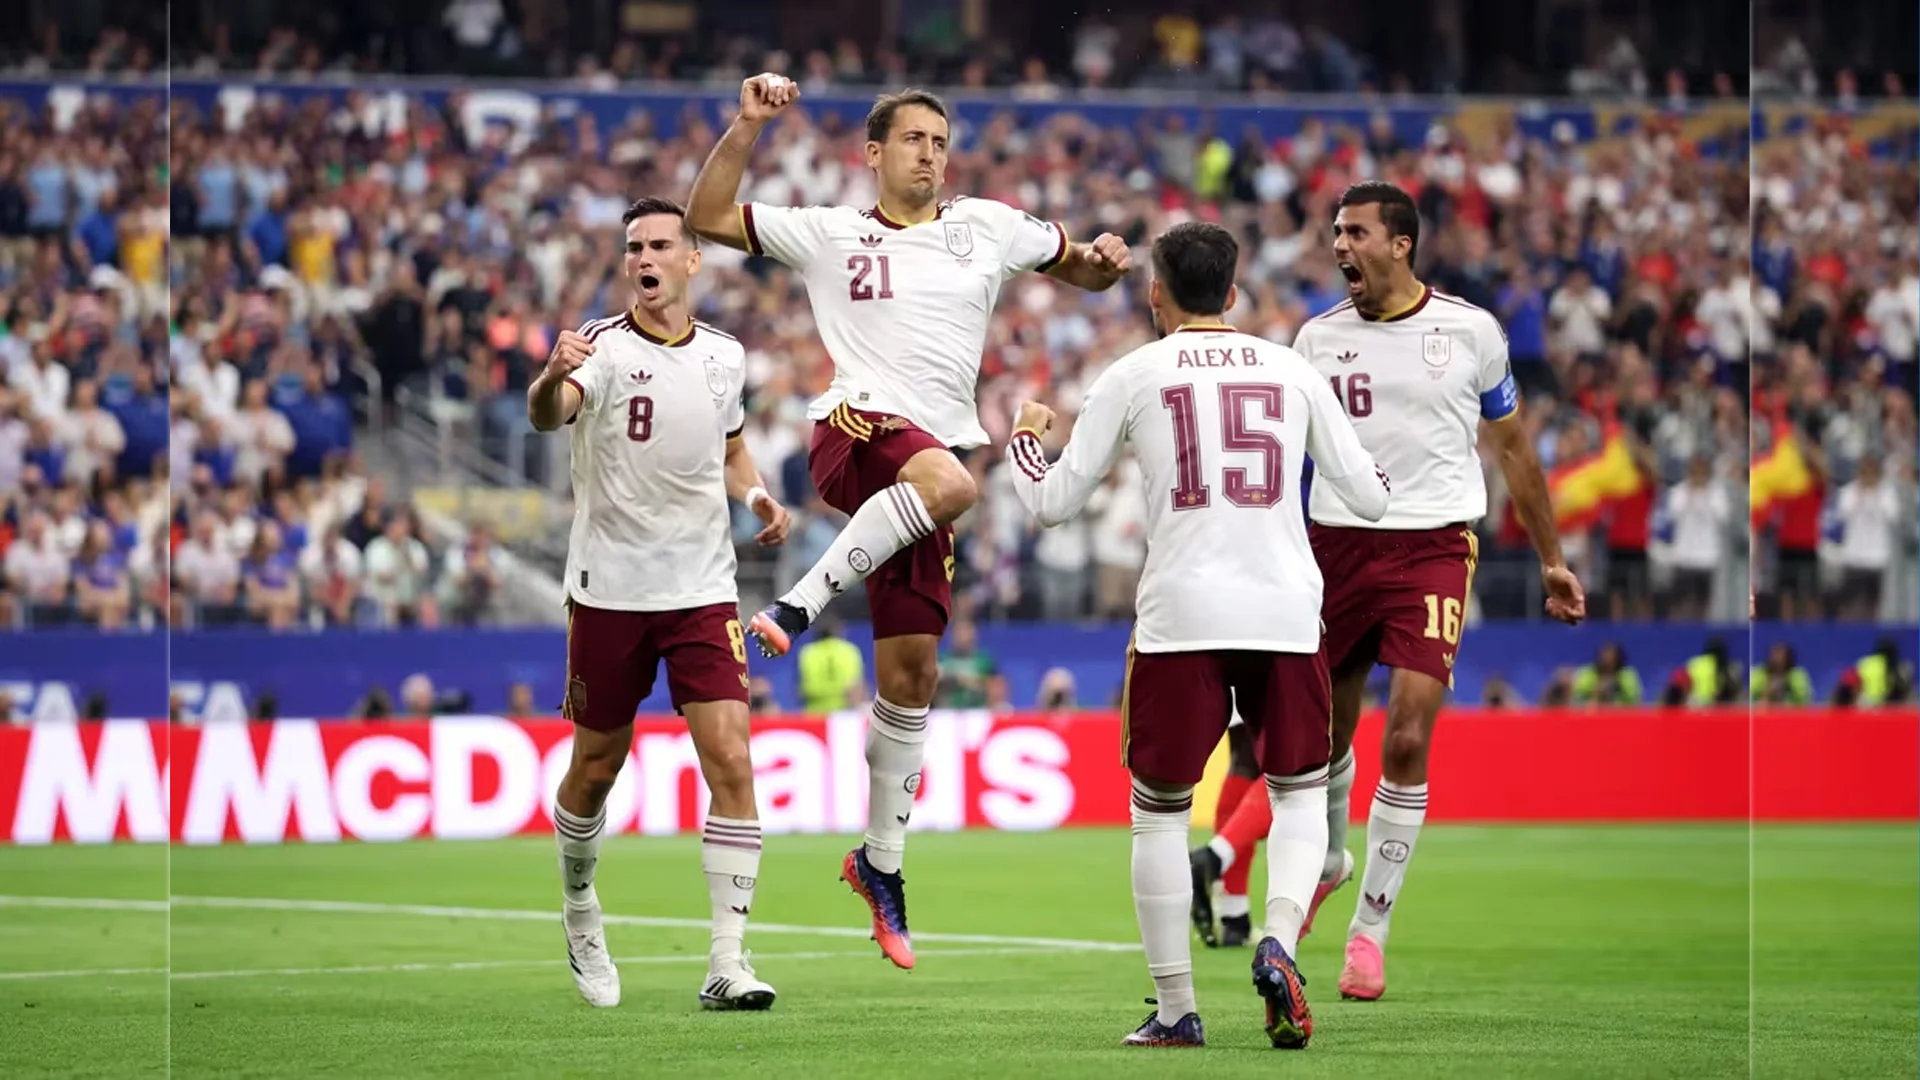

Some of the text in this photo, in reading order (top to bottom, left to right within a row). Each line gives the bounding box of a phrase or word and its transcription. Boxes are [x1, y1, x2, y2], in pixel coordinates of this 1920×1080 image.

[848, 255, 894, 301] 21
[1177, 347, 1264, 368] ALEX B.
[627, 396, 654, 442] 8
[1160, 382, 1284, 512] 15
[725, 619, 747, 664] 8
[1424, 594, 1461, 645] 16
[181, 709, 1076, 844] McDonald's
